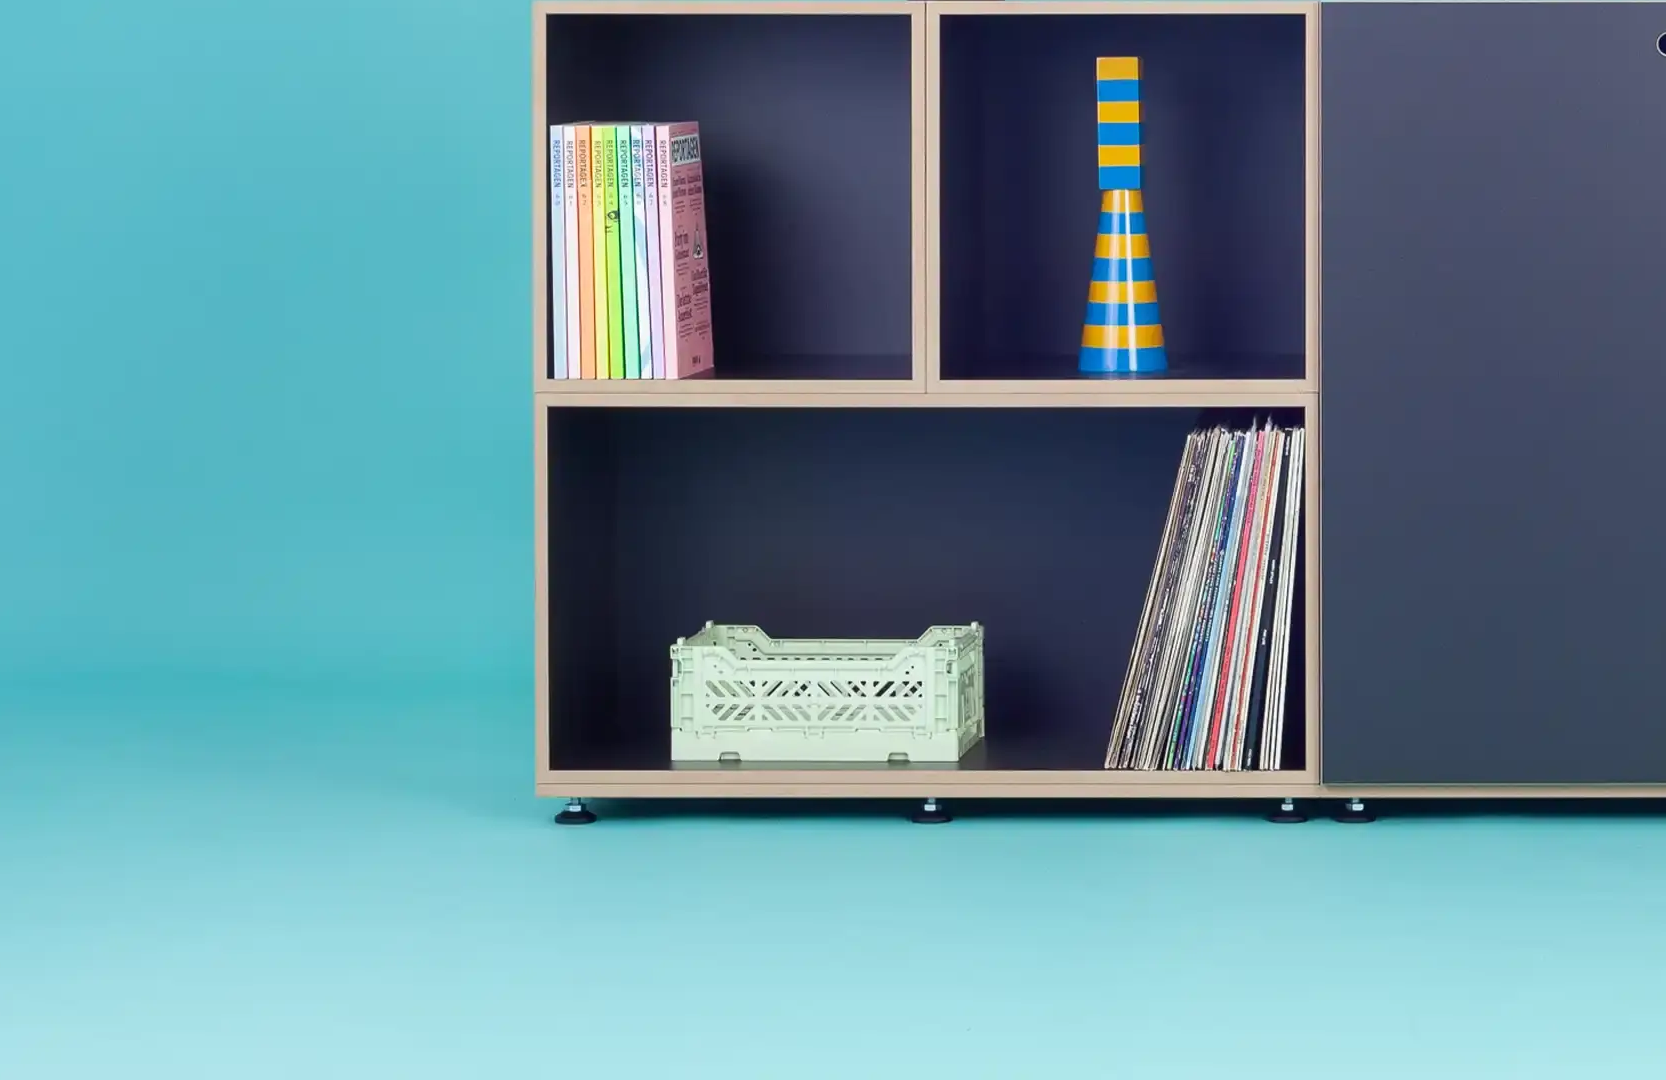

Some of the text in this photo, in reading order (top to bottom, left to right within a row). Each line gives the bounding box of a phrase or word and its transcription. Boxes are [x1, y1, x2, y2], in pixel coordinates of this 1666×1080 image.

[552, 139, 562, 188] REPORTAGEN
[566, 140, 574, 189] REPORTAGEN
[579, 139, 588, 188] REPORTAGEN
[594, 140, 603, 189] REPORTAGEN
[606, 139, 615, 188] REPORTAGEN
[620, 139, 629, 188] REPORTAGEN
[633, 139, 642, 188] REPORTAGEN
[645, 139, 654, 188] REPORTAGEN
[659, 139, 669, 188] REPORTAGEN
